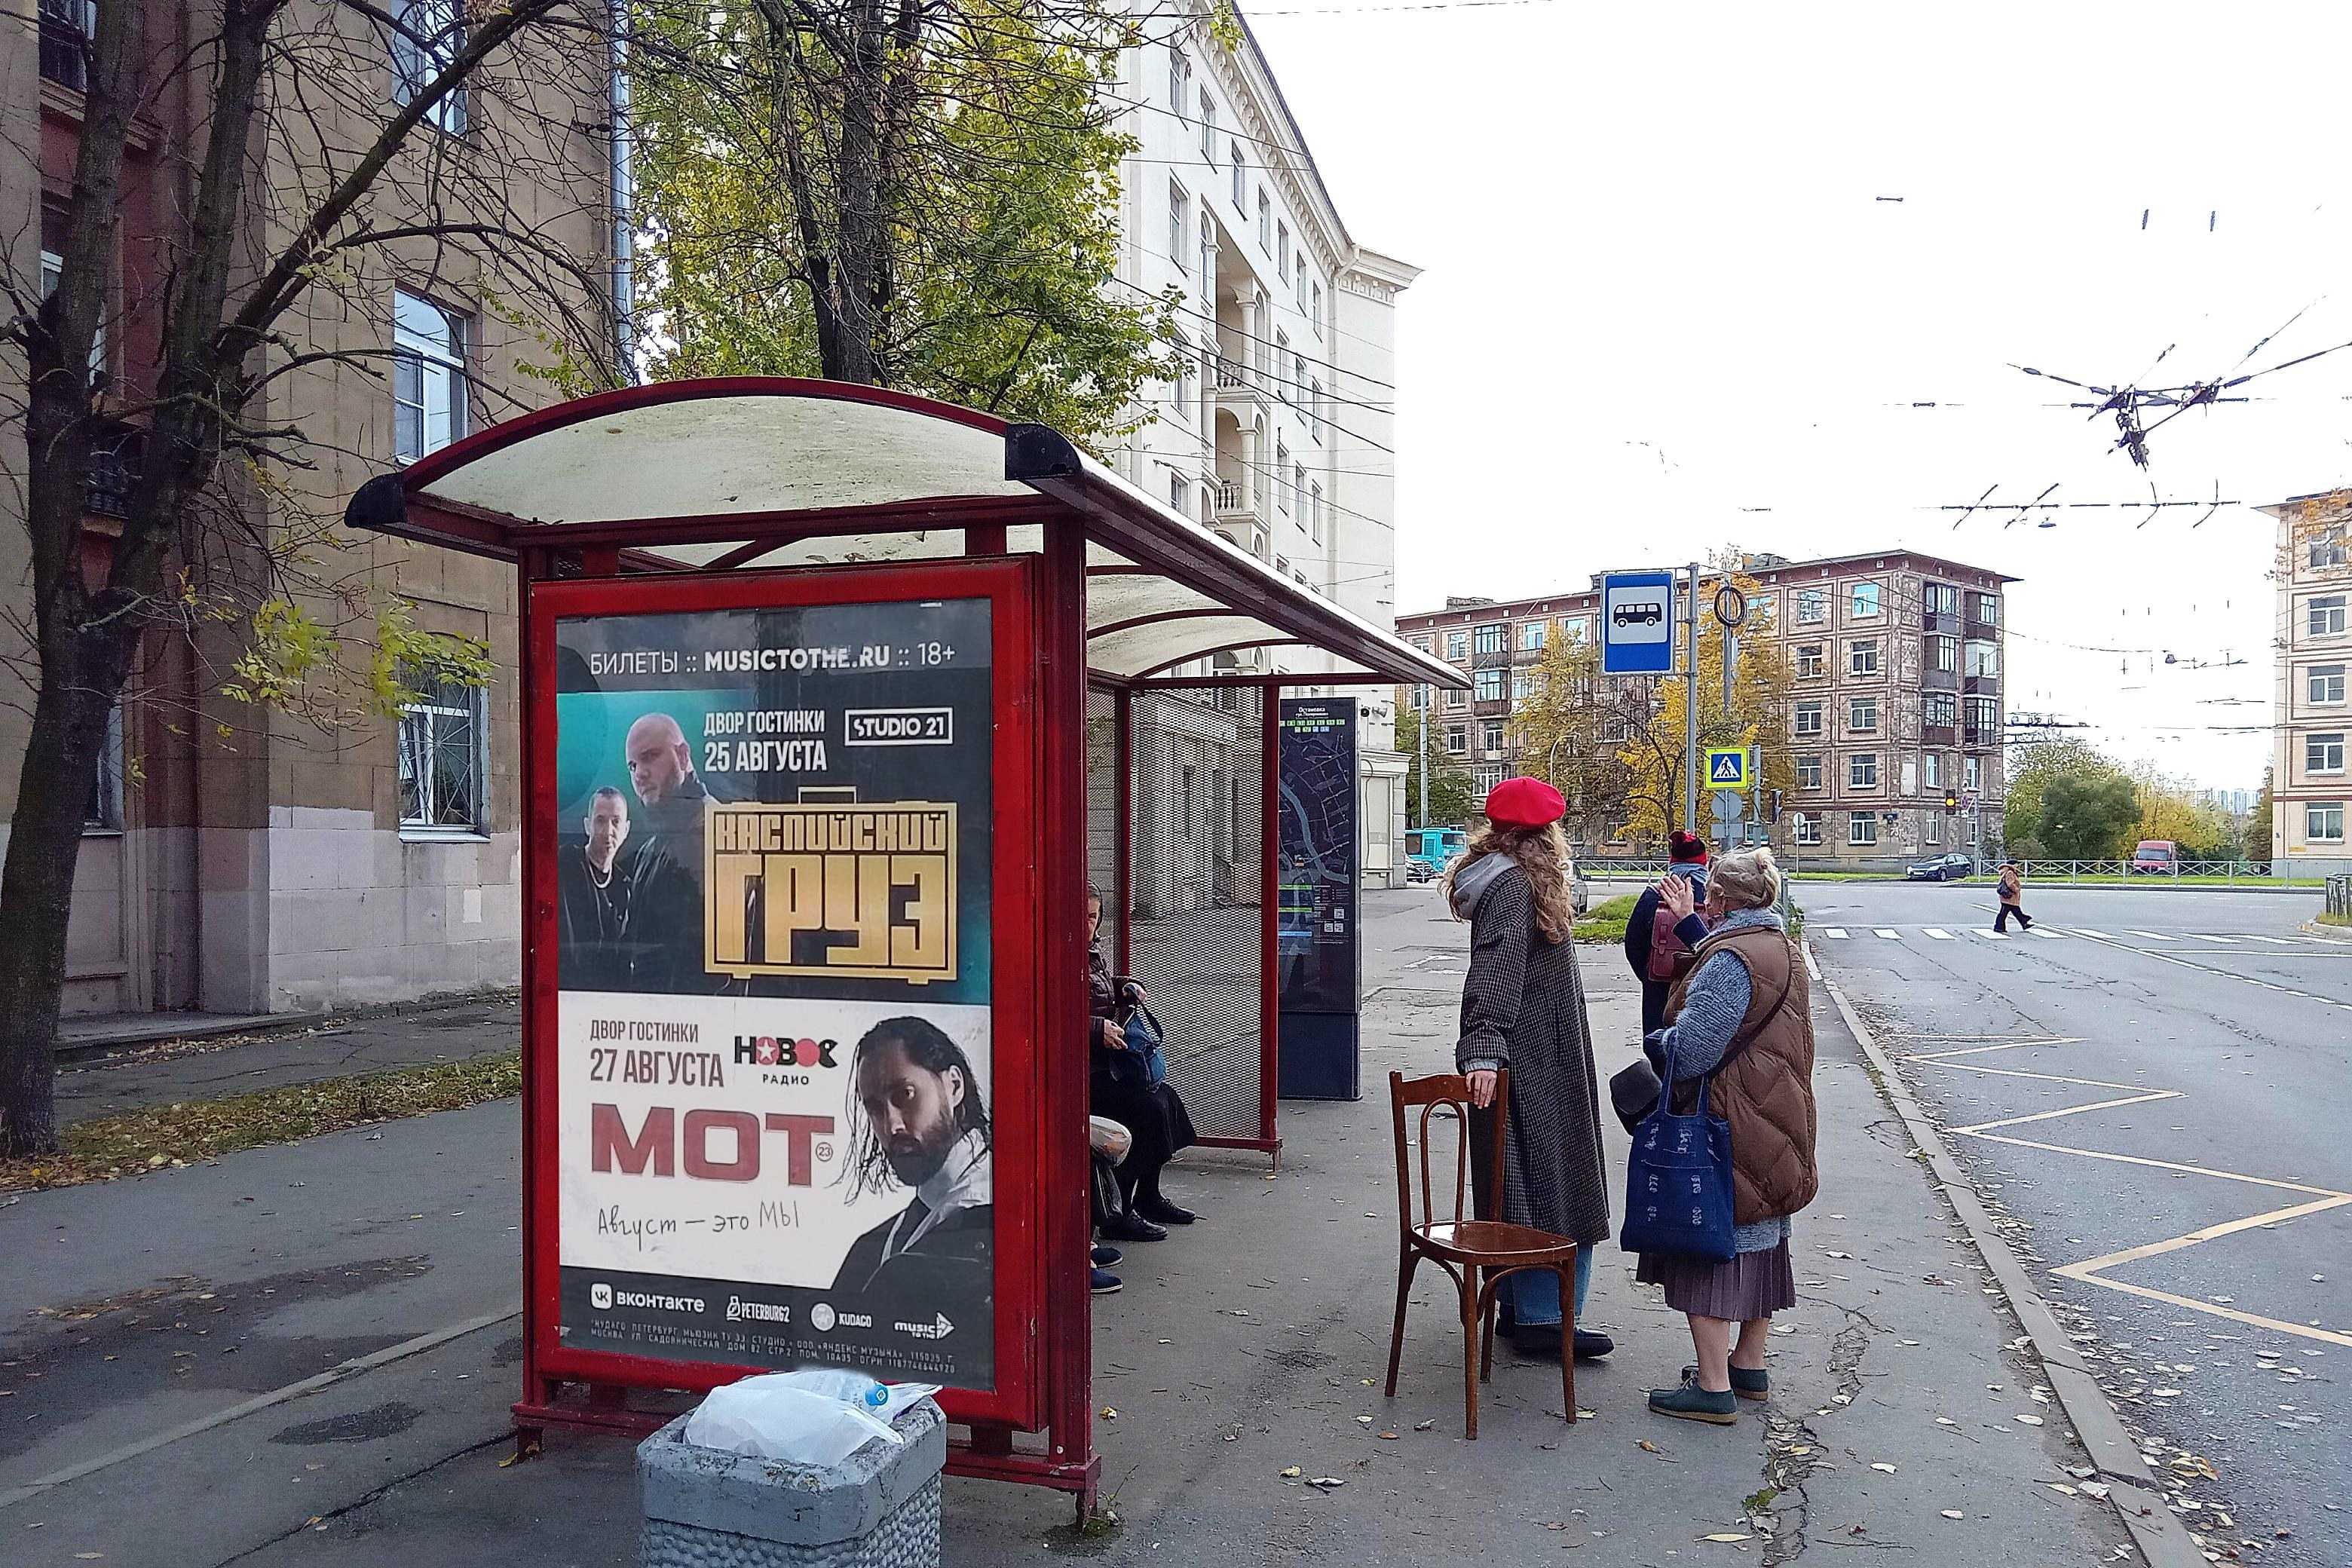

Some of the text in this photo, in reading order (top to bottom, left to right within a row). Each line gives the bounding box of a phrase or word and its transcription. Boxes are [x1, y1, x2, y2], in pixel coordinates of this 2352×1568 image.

[590, 651, 678, 675] БИЛЕТЫ
[704, 645, 890, 672] MUSICTOTHE.RU
[917, 643, 955, 665] 18+
[703, 710, 825, 737] ДВОР ГОСТИНКИ
[854, 717, 945, 737] STUDIO 21
[704, 740, 828, 772] 25 АВГУСТА
[715, 813, 947, 851] КАСПИЙСКИЙ
[715, 854, 946, 969] ГРУЗ
[590, 1020, 699, 1043] ДВОР ГОСТИНКИ
[590, 1049, 724, 1087] 27 АВГУСТА
[763, 1073, 809, 1086] РАДИО
[592, 1103, 835, 1188] МОТ
[598, 1206, 677, 1251] Август
[712, 1214, 749, 1233] это
[759, 1200, 799, 1230] МЫ
[742, 1303, 790, 1322] PETERBURG2
[592, 1328, 623, 1339] МОСКВА
[648, 1334, 719, 1349] САДОВНИЧЕСКАЯ
[727, 1342, 746, 1352] ДОМ
[859, 1355, 882, 1366] ОГРН
[632, 1323, 678, 1335] ПЕТЕРБУРГ
[752, 1335, 786, 1346] СТУДИО
[797, 1340, 813, 1349] ООО
